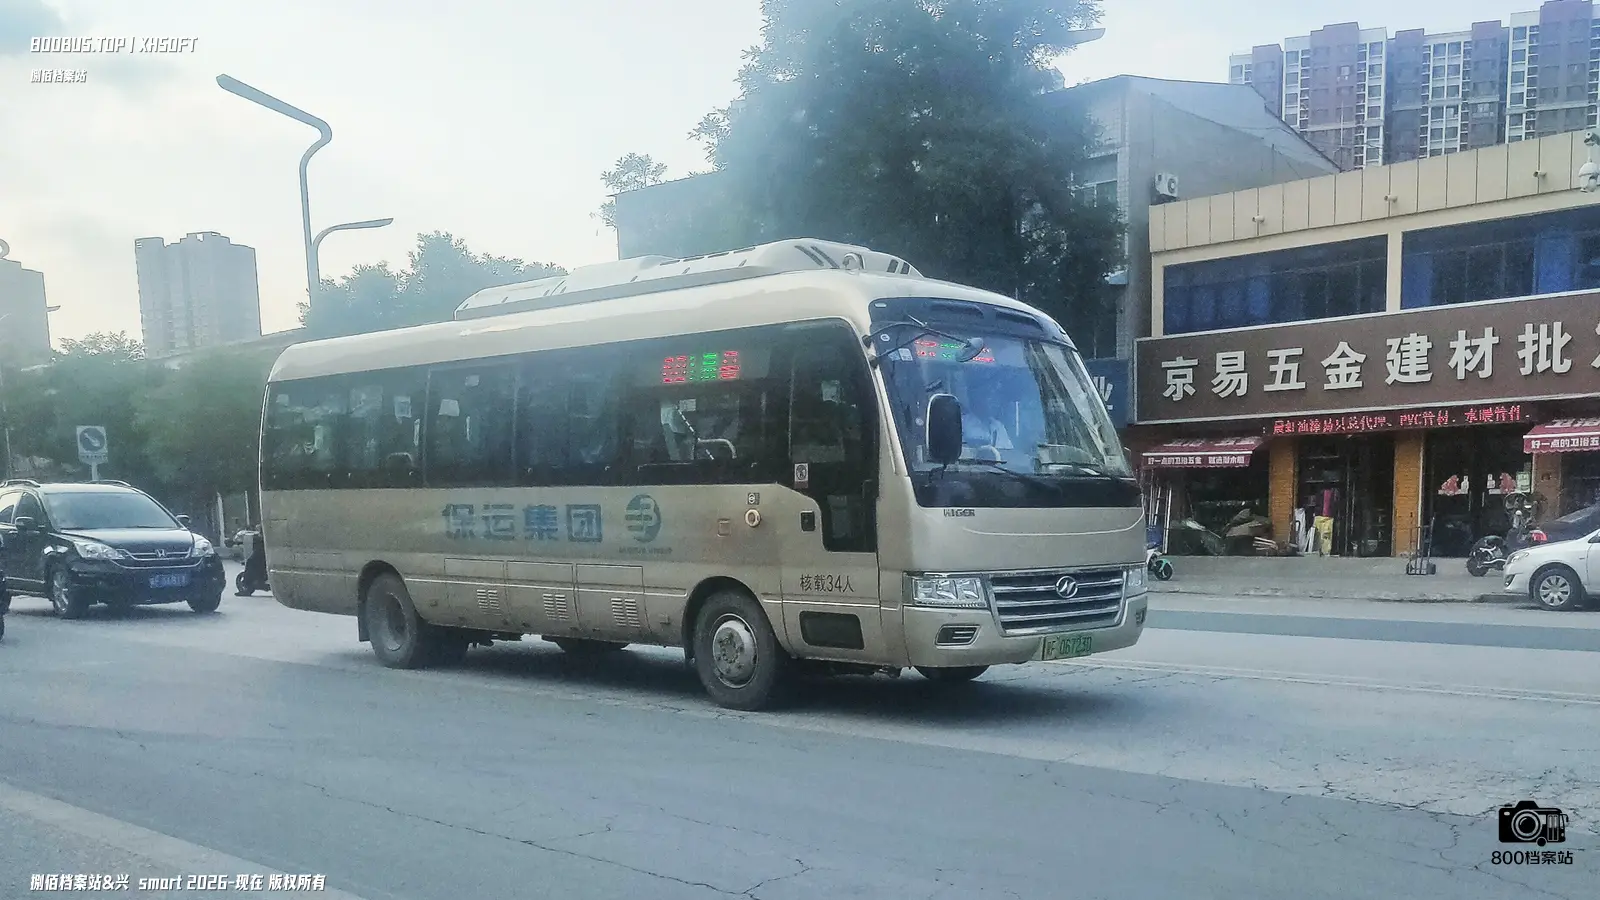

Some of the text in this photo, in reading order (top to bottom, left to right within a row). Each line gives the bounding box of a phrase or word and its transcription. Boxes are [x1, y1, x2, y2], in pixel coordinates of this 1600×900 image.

[1161, 320, 1600, 402] 京易五金建材批
[442, 503, 603, 543] 保运集团
[800, 574, 855, 593] 核载34人
